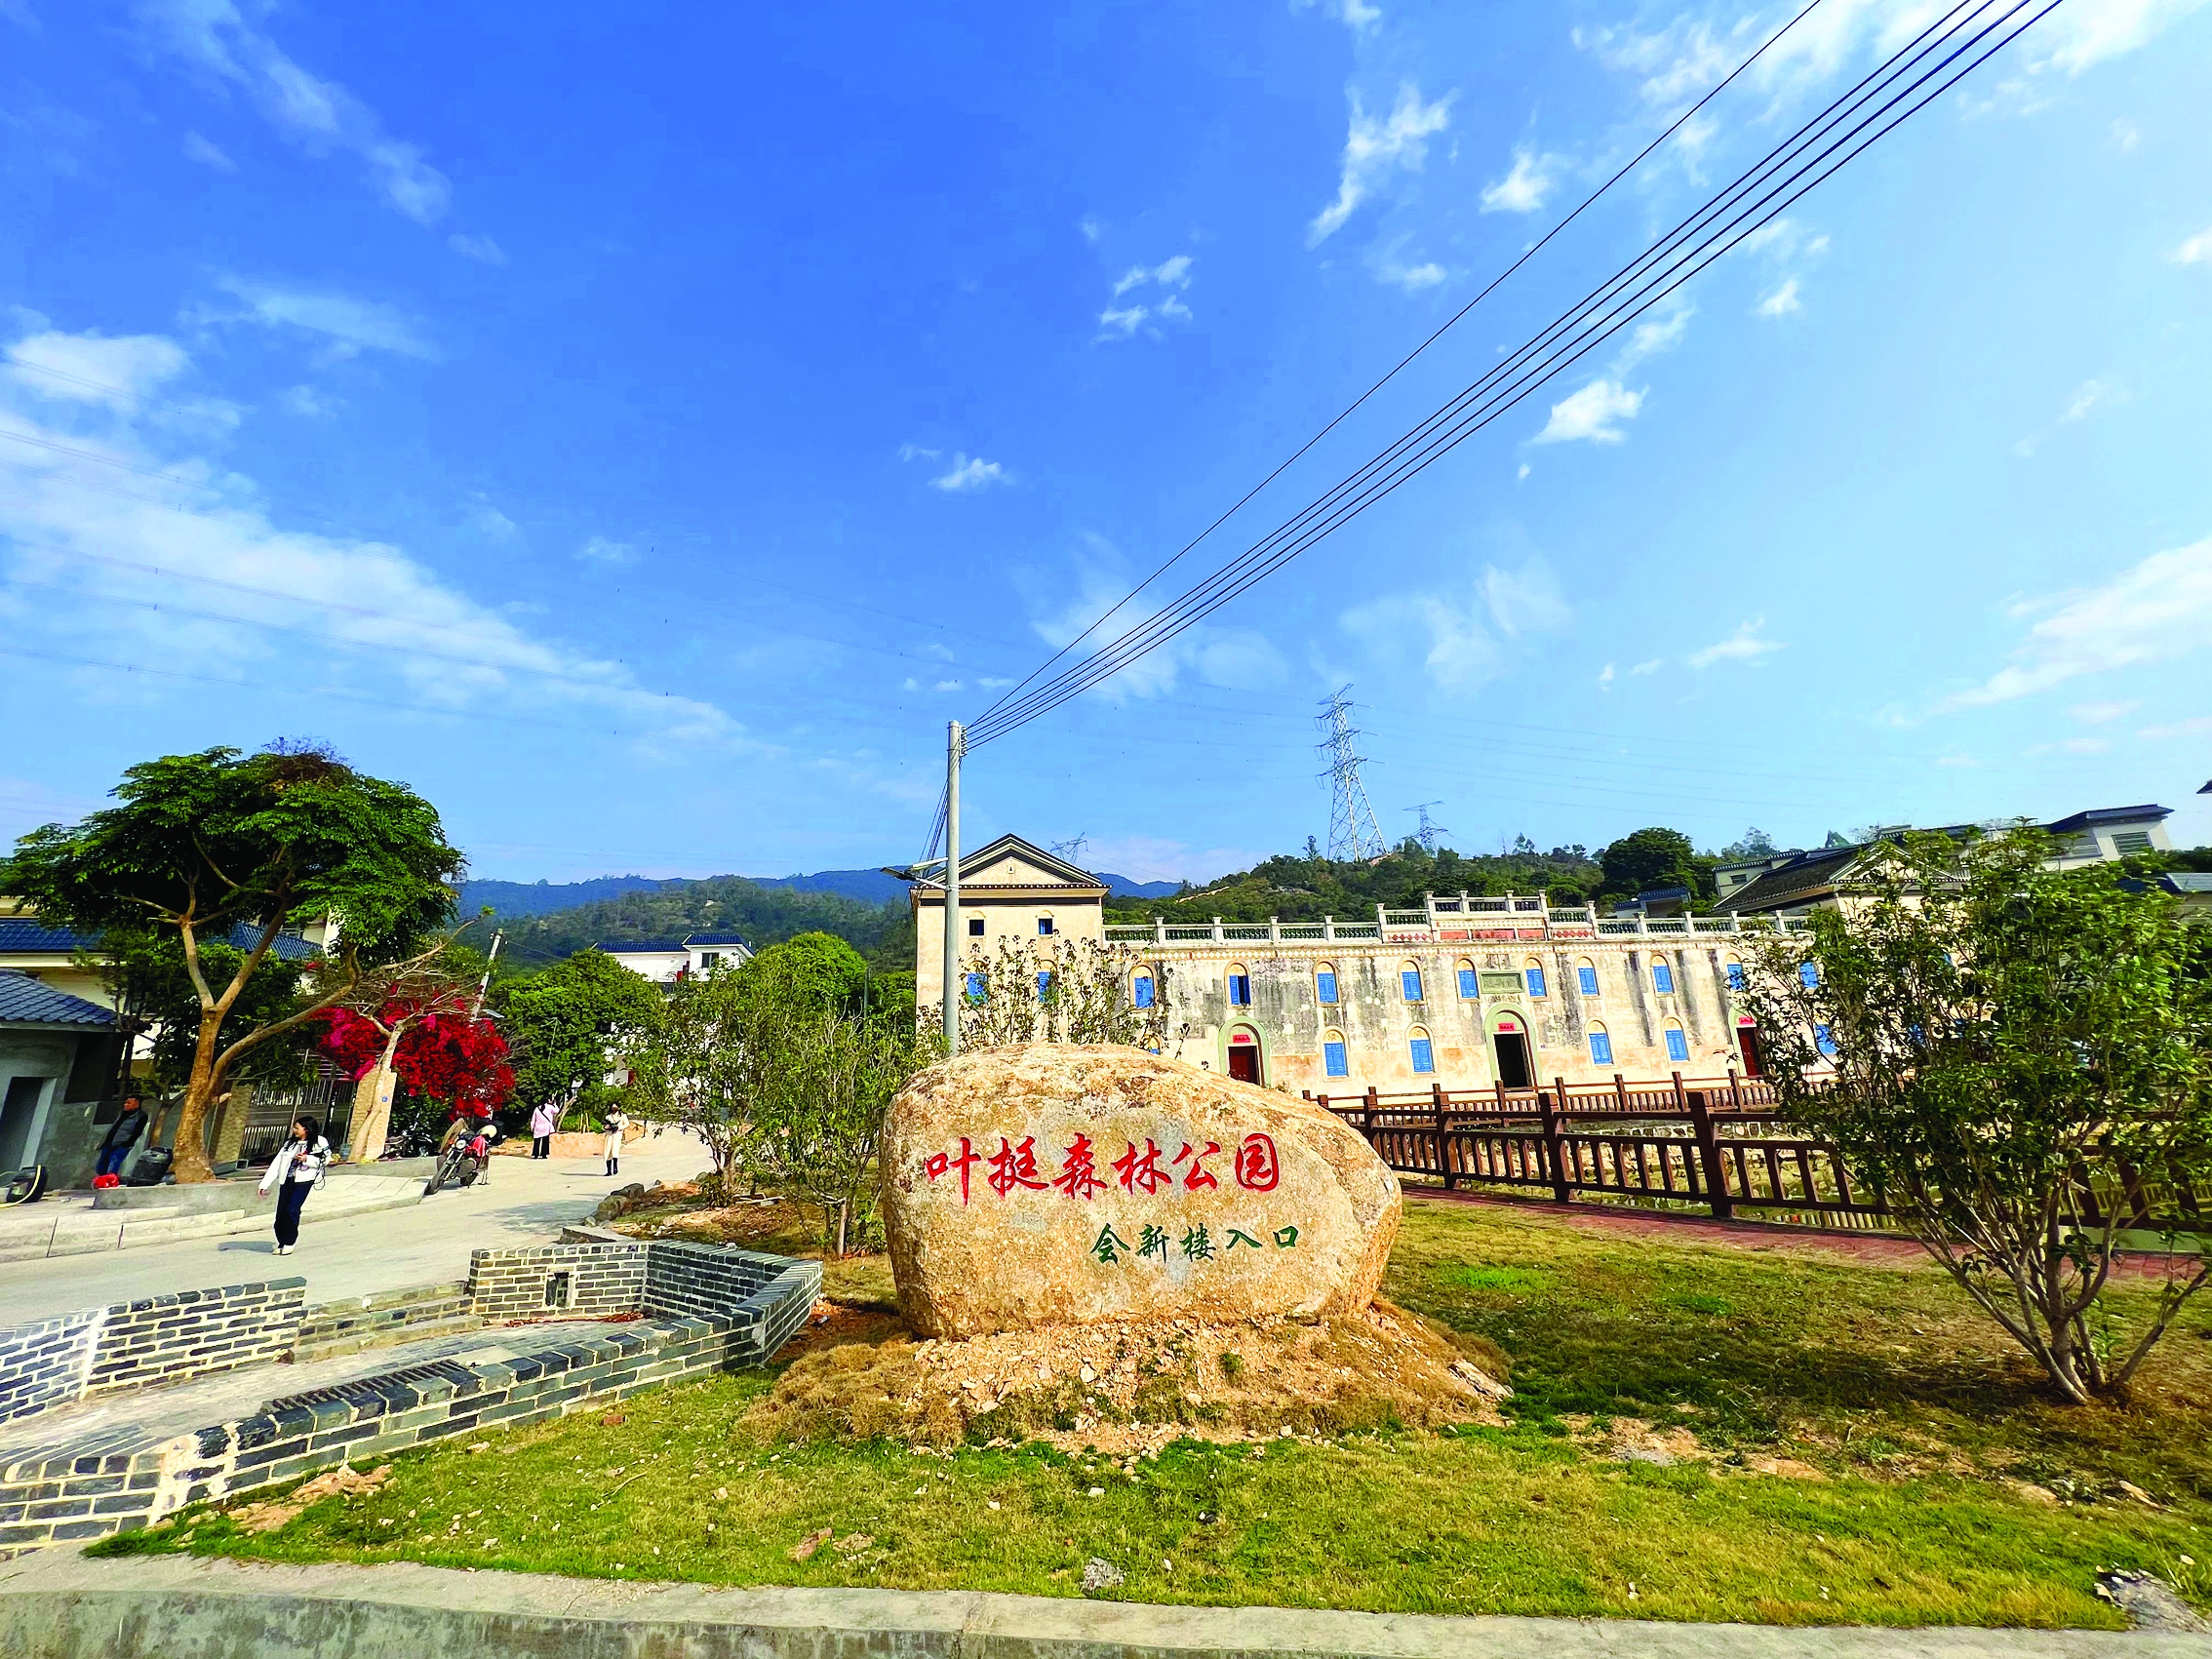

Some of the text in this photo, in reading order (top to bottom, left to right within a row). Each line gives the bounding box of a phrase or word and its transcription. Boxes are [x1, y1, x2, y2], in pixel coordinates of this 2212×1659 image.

[925, 1132, 1280, 1206] 叶挺森林公园
[1090, 1223, 1299, 1264] 会新楼入口
